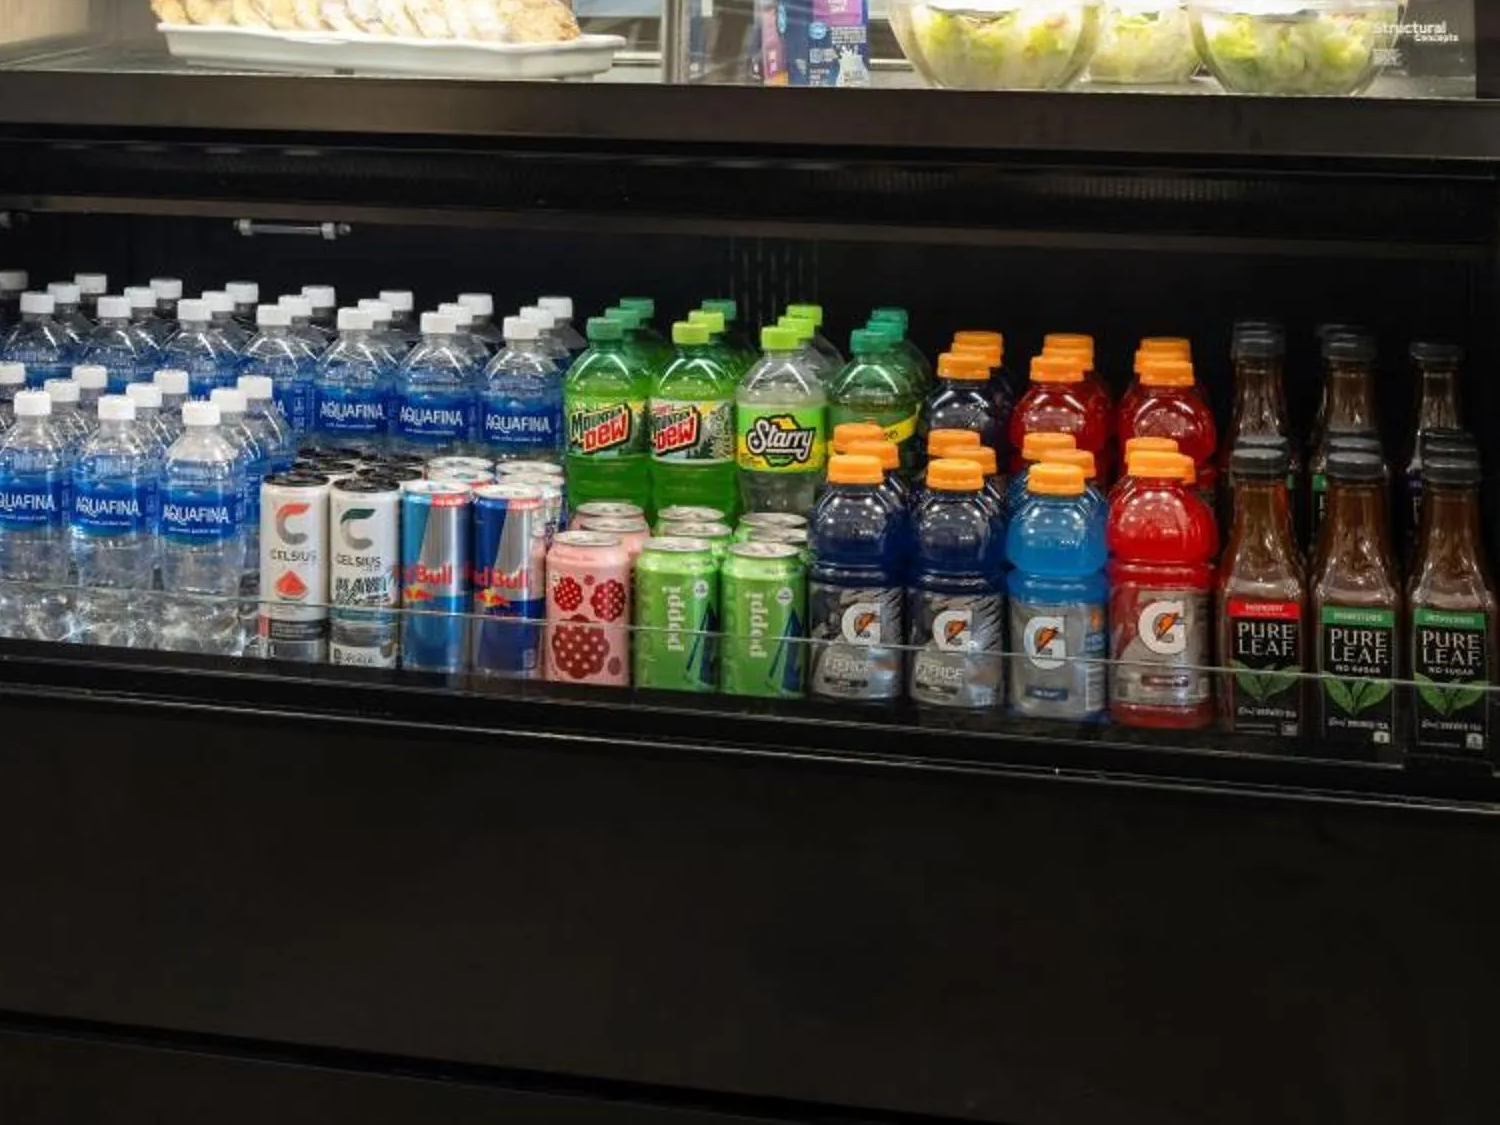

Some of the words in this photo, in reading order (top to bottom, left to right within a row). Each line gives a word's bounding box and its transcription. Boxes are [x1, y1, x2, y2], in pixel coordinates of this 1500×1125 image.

[320, 401, 385, 421] AQUAFINA
[400, 405, 463, 426] AQUAFINA
[486, 413, 551, 433] AQUAFINA
[747, 420, 813, 461] Starry
[75, 496, 142, 517] AQUAFINA
[163, 504, 231, 525] AQUAFINA
[335, 553, 382, 567] CELSIUS
[663, 586, 684, 651] poppi
[747, 592, 768, 658] poppi
[1237, 623, 1295, 640] PURE
[1331, 628, 1388, 648] PURE
[1421, 630, 1481, 650] PURE
[1237, 639, 1294, 657] LEAF
[1331, 647, 1388, 664] LEAF
[1422, 648, 1481, 666] LEAF
